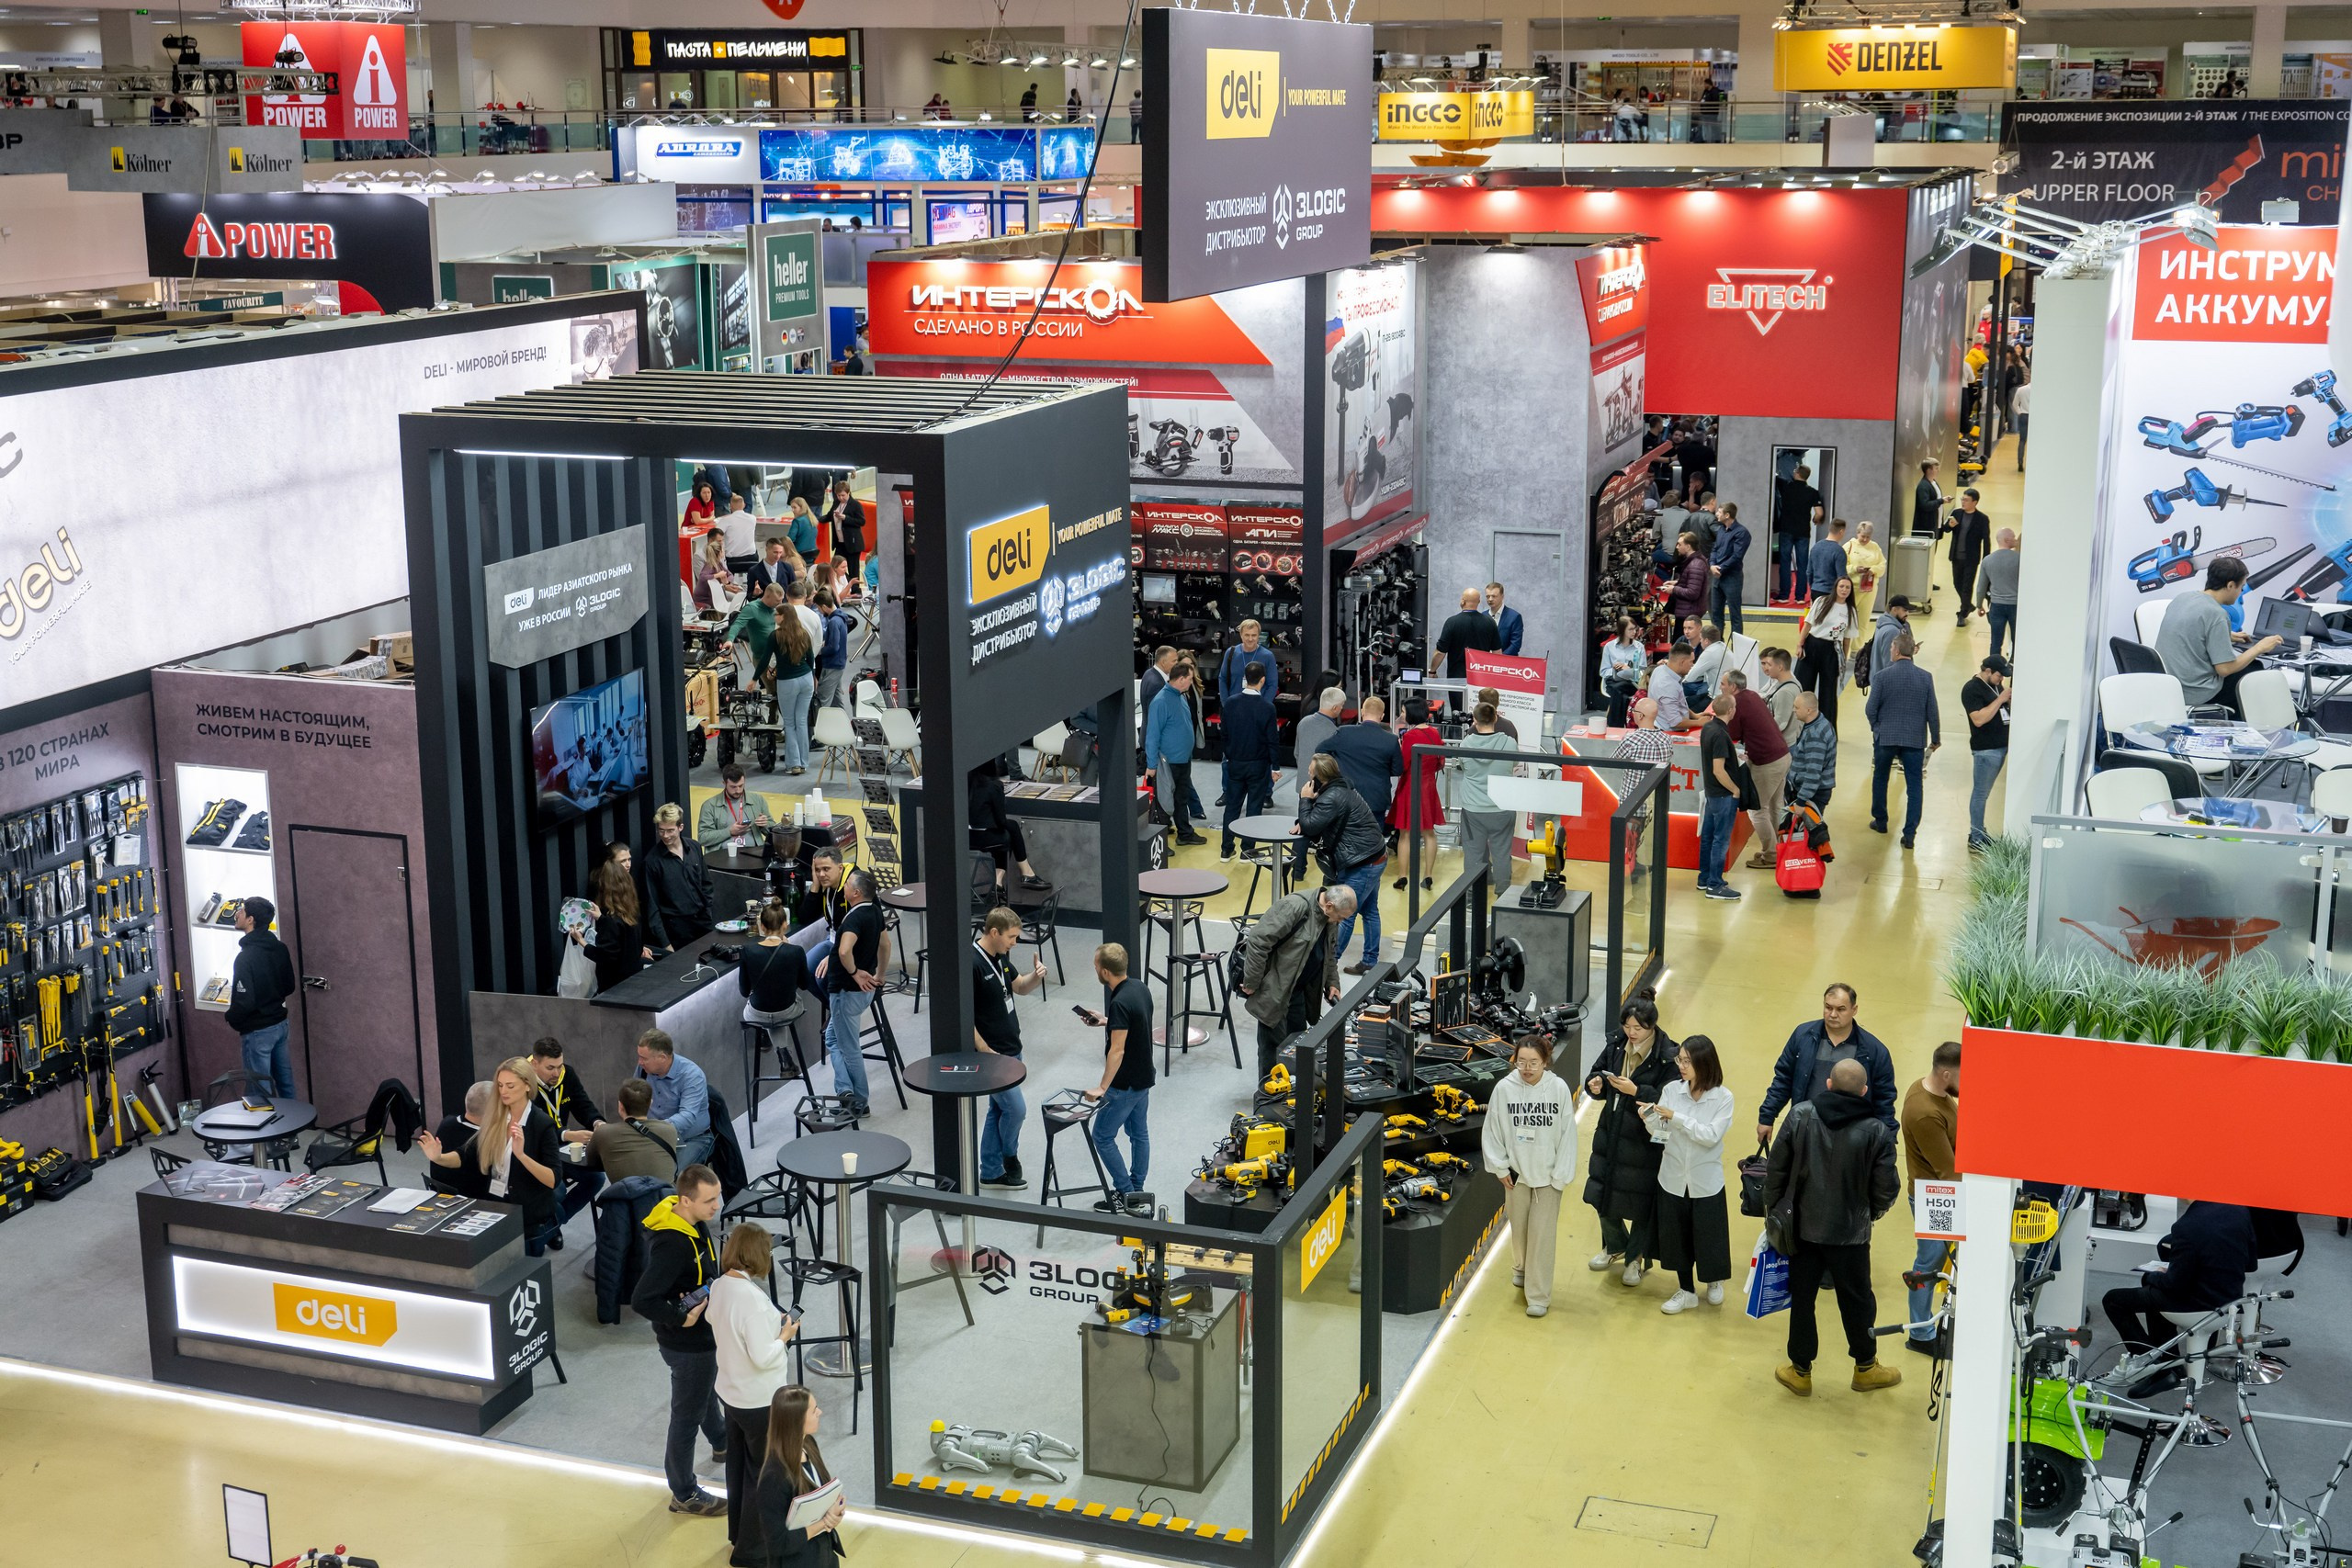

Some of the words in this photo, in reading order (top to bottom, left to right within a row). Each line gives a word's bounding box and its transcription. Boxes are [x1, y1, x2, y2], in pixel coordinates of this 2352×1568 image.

[667, 41, 712, 58] ПАСТА
[726, 40, 807, 57] ПЕЛЬМЕНИ
[1857, 40, 1942, 73] DENZEL
[1220, 70, 1261, 119] deli
[1288, 89, 1304, 106] YOUR
[1304, 89, 1331, 106] POWERFUL
[1332, 89, 1347, 106] MATE
[264, 107, 327, 129] POWER
[354, 107, 398, 129] POWER
[2017, 112, 2103, 123] ПРОДОЛЖЕНИЕ
[2105, 111, 2183, 123] ЭКСПОЗИЦИИ
[2185, 109, 2204, 121] 2-Й
[2206, 110, 2238, 121] ЭТАЖ
[2249, 110, 2269, 120] THE
[2271, 110, 2335, 121] EXPOSITION
[658, 142, 738, 153] AURORA
[2051, 150, 2086, 170] 2-й
[2091, 151, 2155, 171] ЭТАЖ
[126, 153, 172, 174] Kölner
[245, 153, 292, 173] Kölner
[1205, 192, 1267, 220] ЭКСКЛЮЗИВНЫЙ
[1295, 187, 1347, 219] 3LOGIC
[2032, 184, 2098, 202] UPPER
[2104, 184, 2175, 203] FLOOR
[223, 222, 337, 260] POWER
[1205, 225, 1267, 256] ДИСТРИБЬЮТОР
[1295, 223, 1324, 242] GROUP
[774, 251, 808, 288] heller
[222, 295, 265, 310] FAVOURITE
[775, 290, 795, 304] PREMIUM
[796, 288, 809, 301] TOOLS
[911, 279, 1145, 321] ИНТЕРСКОЛ
[1707, 284, 1826, 310] ELITECH
[914, 318, 994, 335] СДЕЛАНО
[998, 319, 1008, 335] В
[1012, 320, 1083, 338] РОССИИ
[424, 363, 447, 379] DELI
[457, 349, 509, 374] МИРОВОЙ
[511, 345, 548, 366] БРЕНД!
[1057, 525, 1074, 545] YOUR
[1074, 513, 1106, 537] POWERFUL
[1105, 506, 1123, 526] MATE
[1147, 511, 1224, 524] ИНТЕРСКОЛ
[1231, 514, 1304, 527] ИНТЕРСКО
[987, 527, 1032, 581] deli
[510, 592, 528, 609] deli
[537, 582, 563, 601] ЛИДЕР
[562, 570, 608, 593] АЗИАТСКОГО
[607, 562, 633, 579] РЫНКА
[1067, 557, 1126, 602] 3LOGIC
[589, 587, 621, 606] 3LOGIC
[589, 603, 607, 613] GROUP
[7, 638, 32, 665] YOUR
[29, 600, 74, 645] POWERFUL
[70, 578, 93, 605] MATE
[518, 617, 536, 632] УЖЕ
[536, 615, 542, 627] В
[542, 605, 571, 626] РОССИИ
[969, 592, 1038, 637] ЭКСКЛЮЗИВНЫЙ
[970, 620, 1038, 666] ДИСТРИБЬЮТОР
[1470, 662, 1541, 681] ИНТЕРСКОЛ
[196, 704, 255, 721] ЖИВЕМ
[260, 709, 370, 731] НАСТОЯЩИМ,
[7, 744, 36, 768] 120
[40, 721, 110, 757] СТРАНАХ
[197, 723, 276, 740] СМОТРИМ
[280, 730, 289, 742] В
[295, 732, 372, 749] БУДУЩЕЕ
[34, 753, 81, 782] МИРА
[1926, 1198, 1956, 1209] H501
[1309, 1211, 1337, 1269] deli
[295, 1299, 368, 1336] deli
[508, 1330, 549, 1369] 3LOGIC
[514, 1347, 545, 1376] GROUP
[987, 1443, 1011, 1451] Unitree
